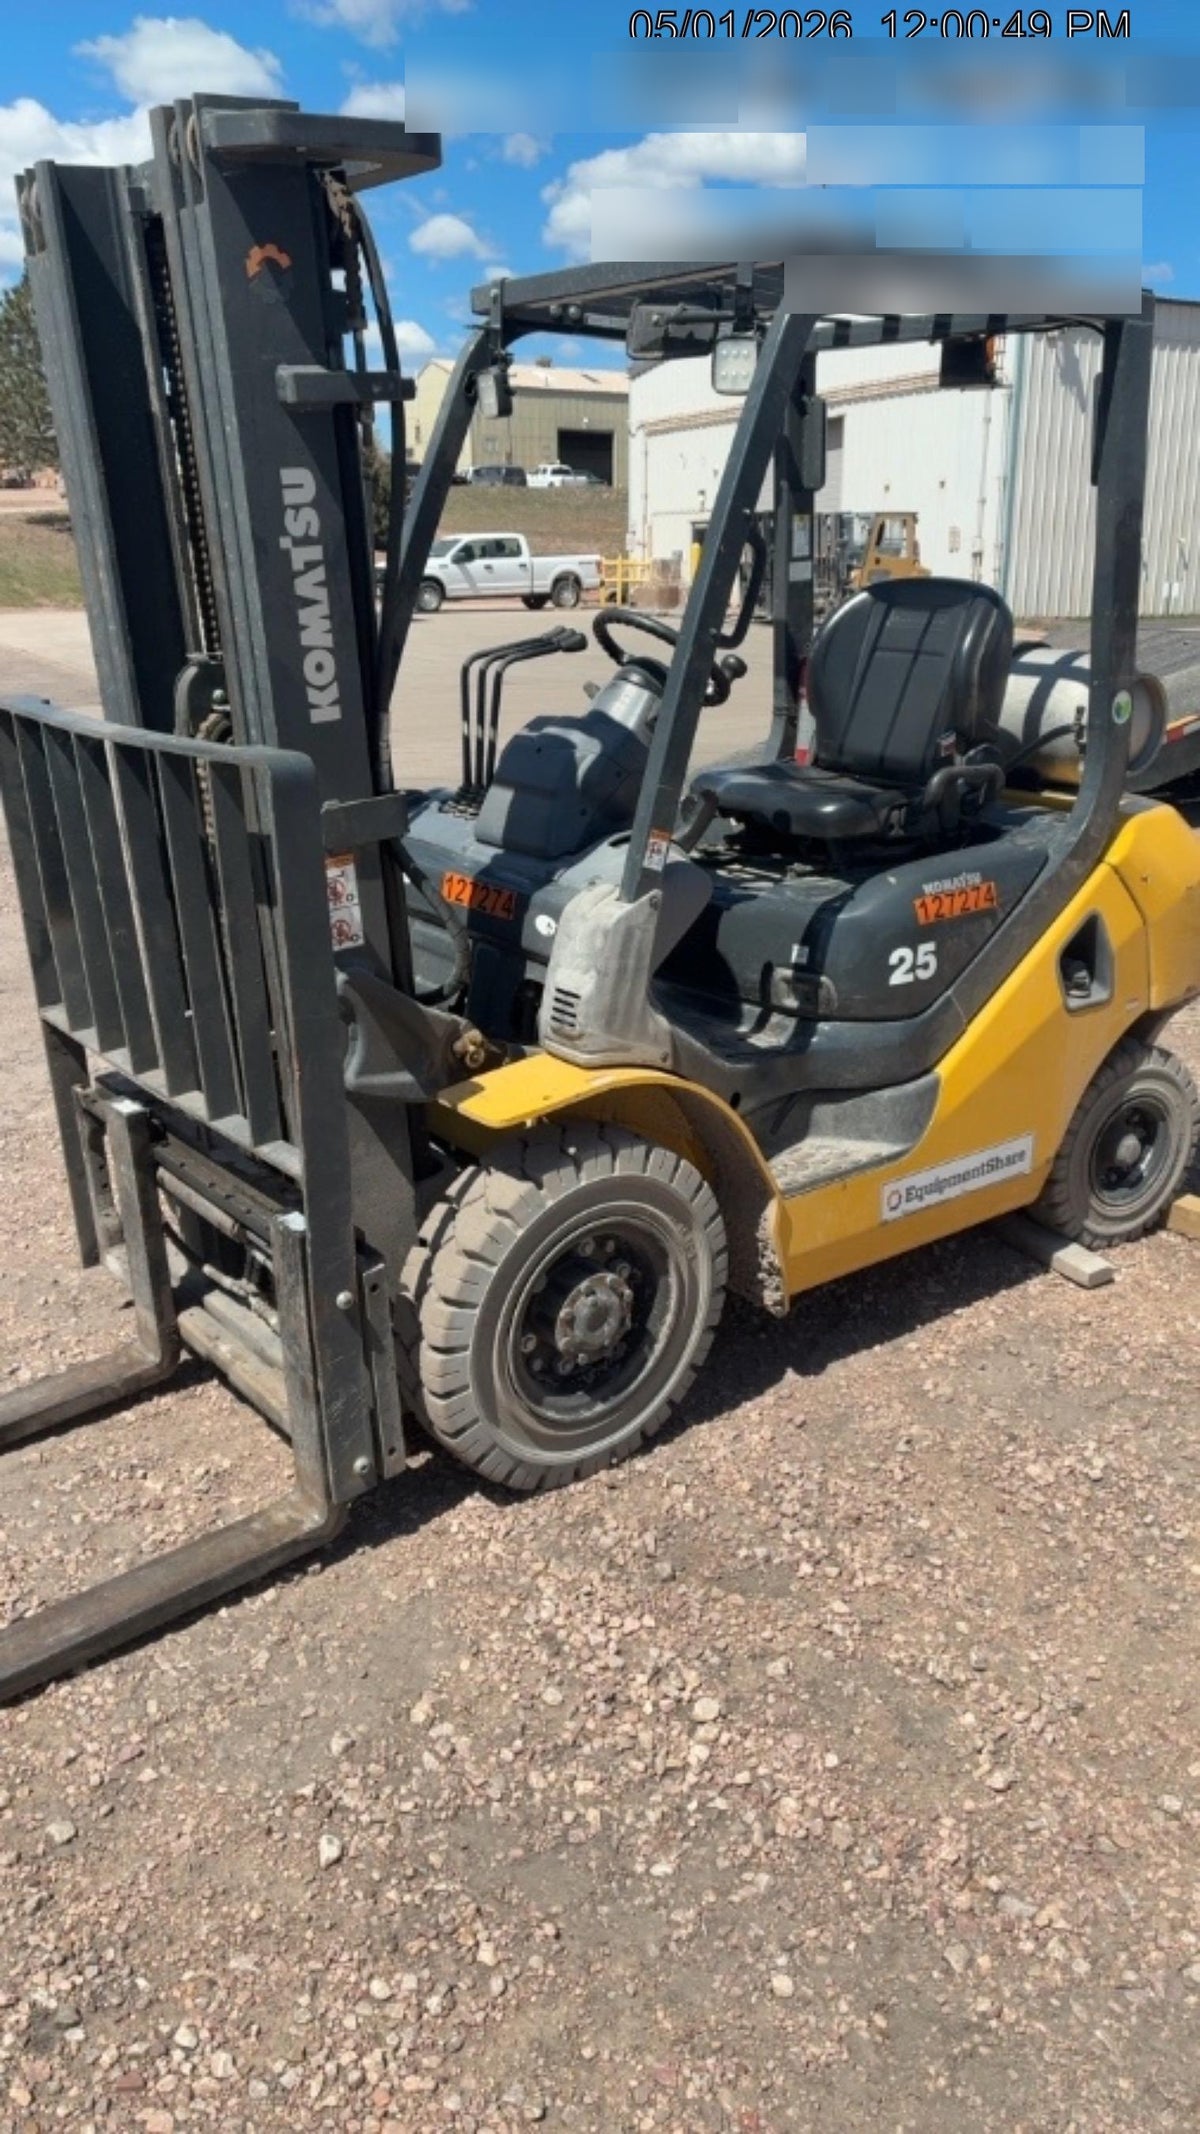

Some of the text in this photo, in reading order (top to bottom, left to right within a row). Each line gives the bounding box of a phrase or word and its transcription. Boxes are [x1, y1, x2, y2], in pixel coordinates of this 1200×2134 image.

[279, 466, 342, 724] KOMATSU
[445, 874, 514, 918] 127274
[918, 883, 995, 921] 127274
[921, 871, 982, 895] KOMATSU
[888, 941, 938, 987] 25
[904, 1149, 1027, 1203] EquipmentShare
